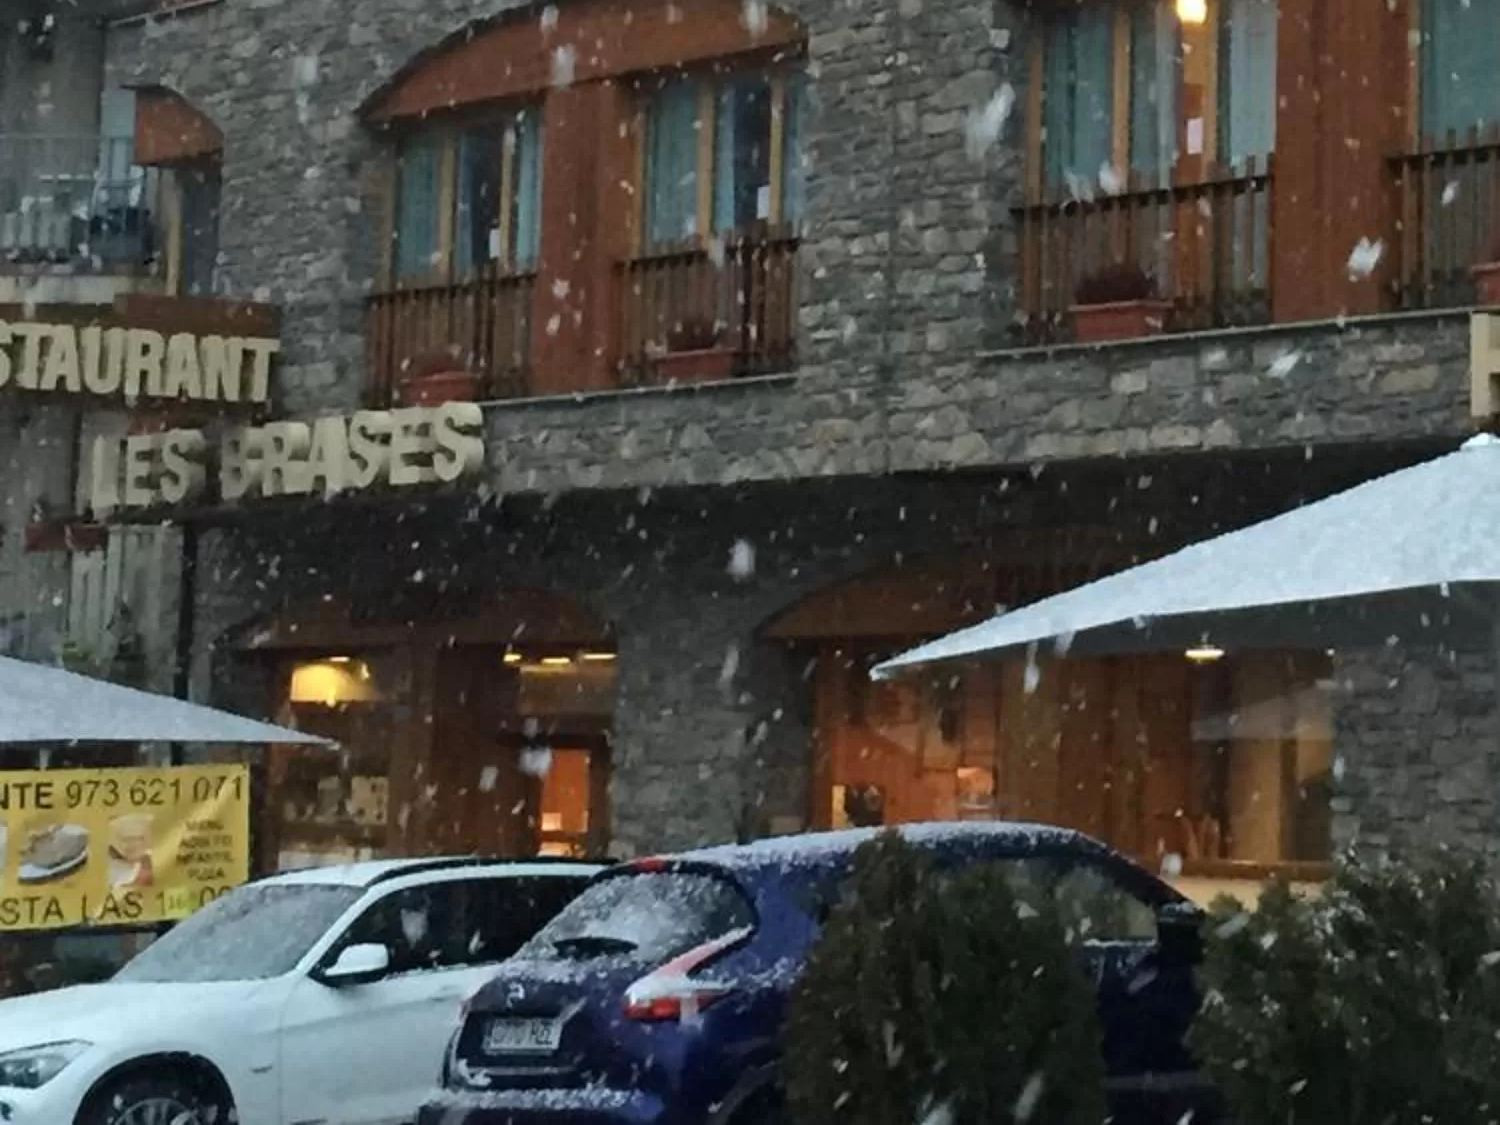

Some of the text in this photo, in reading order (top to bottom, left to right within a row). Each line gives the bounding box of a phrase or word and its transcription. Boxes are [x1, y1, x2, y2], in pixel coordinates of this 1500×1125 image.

[88, 401, 486, 521] LES BRASES
[65, 778, 120, 808] 973
[129, 778, 181, 806] 621
